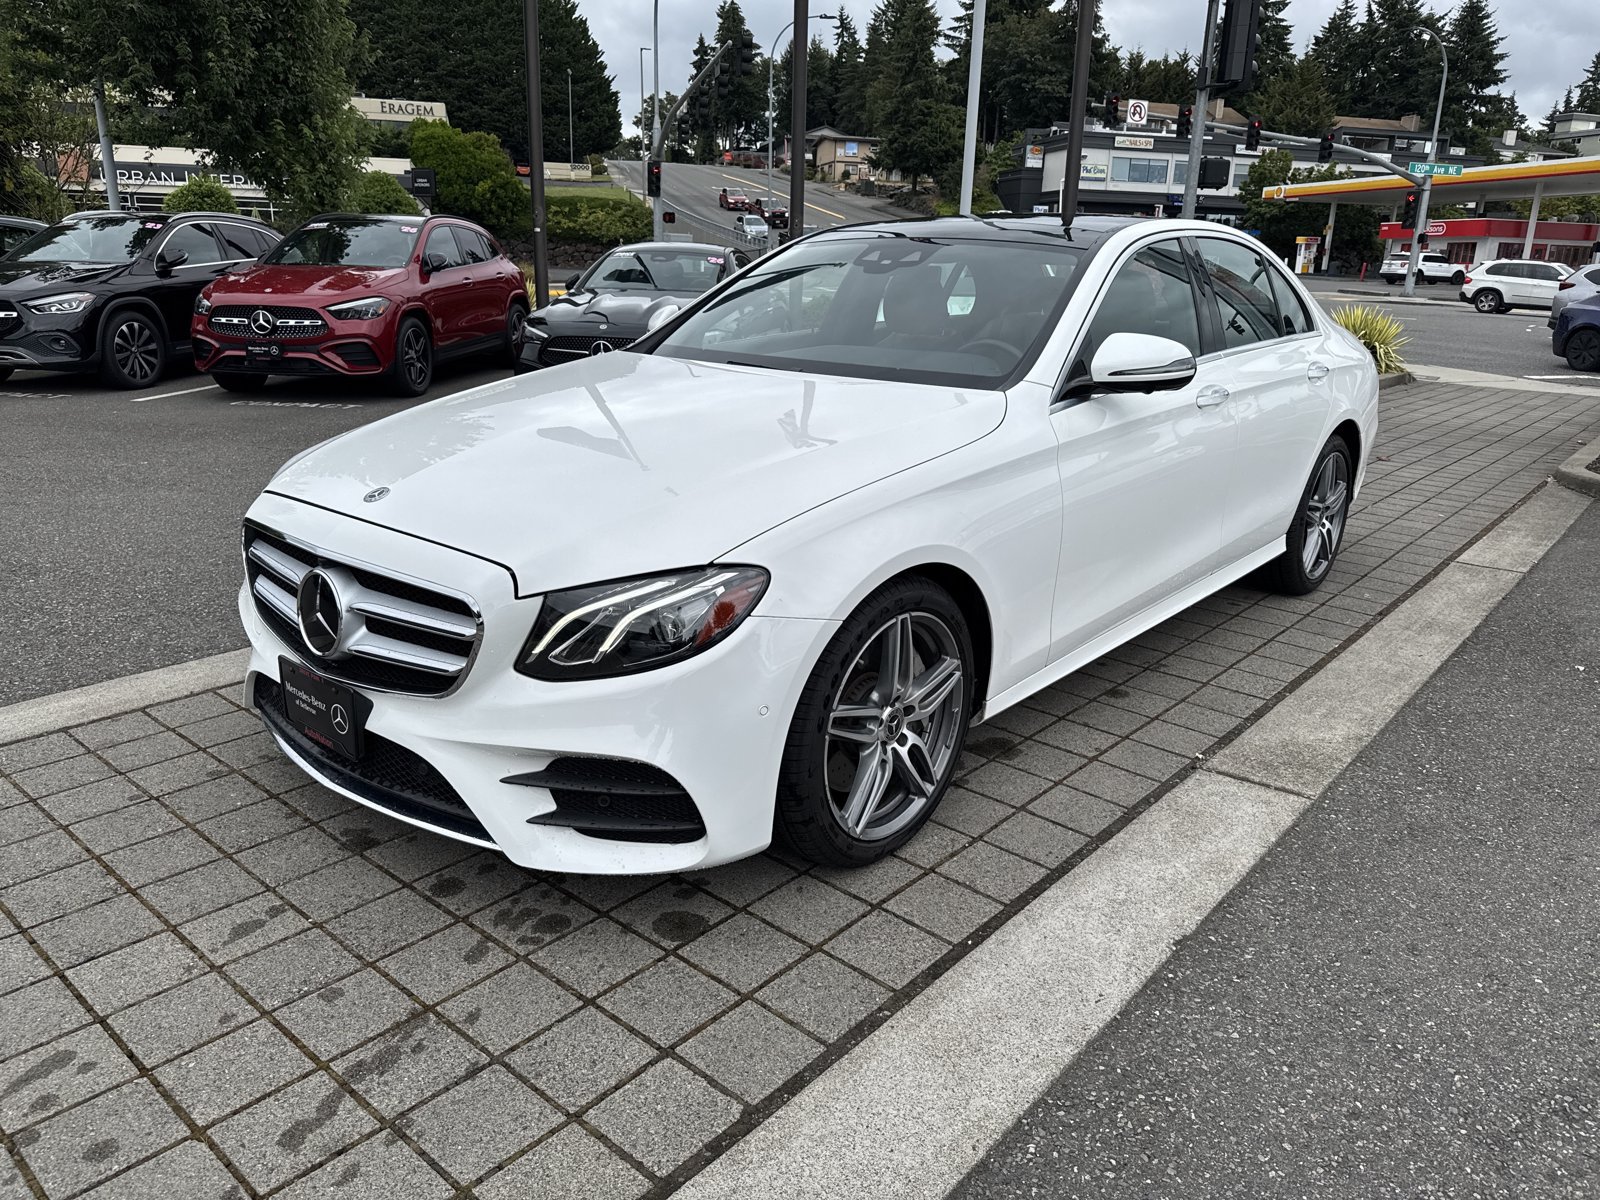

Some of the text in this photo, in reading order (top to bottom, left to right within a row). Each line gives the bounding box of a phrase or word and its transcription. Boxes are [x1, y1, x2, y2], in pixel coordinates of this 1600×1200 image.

[1415, 164, 1458, 175] 120th Ave NE
